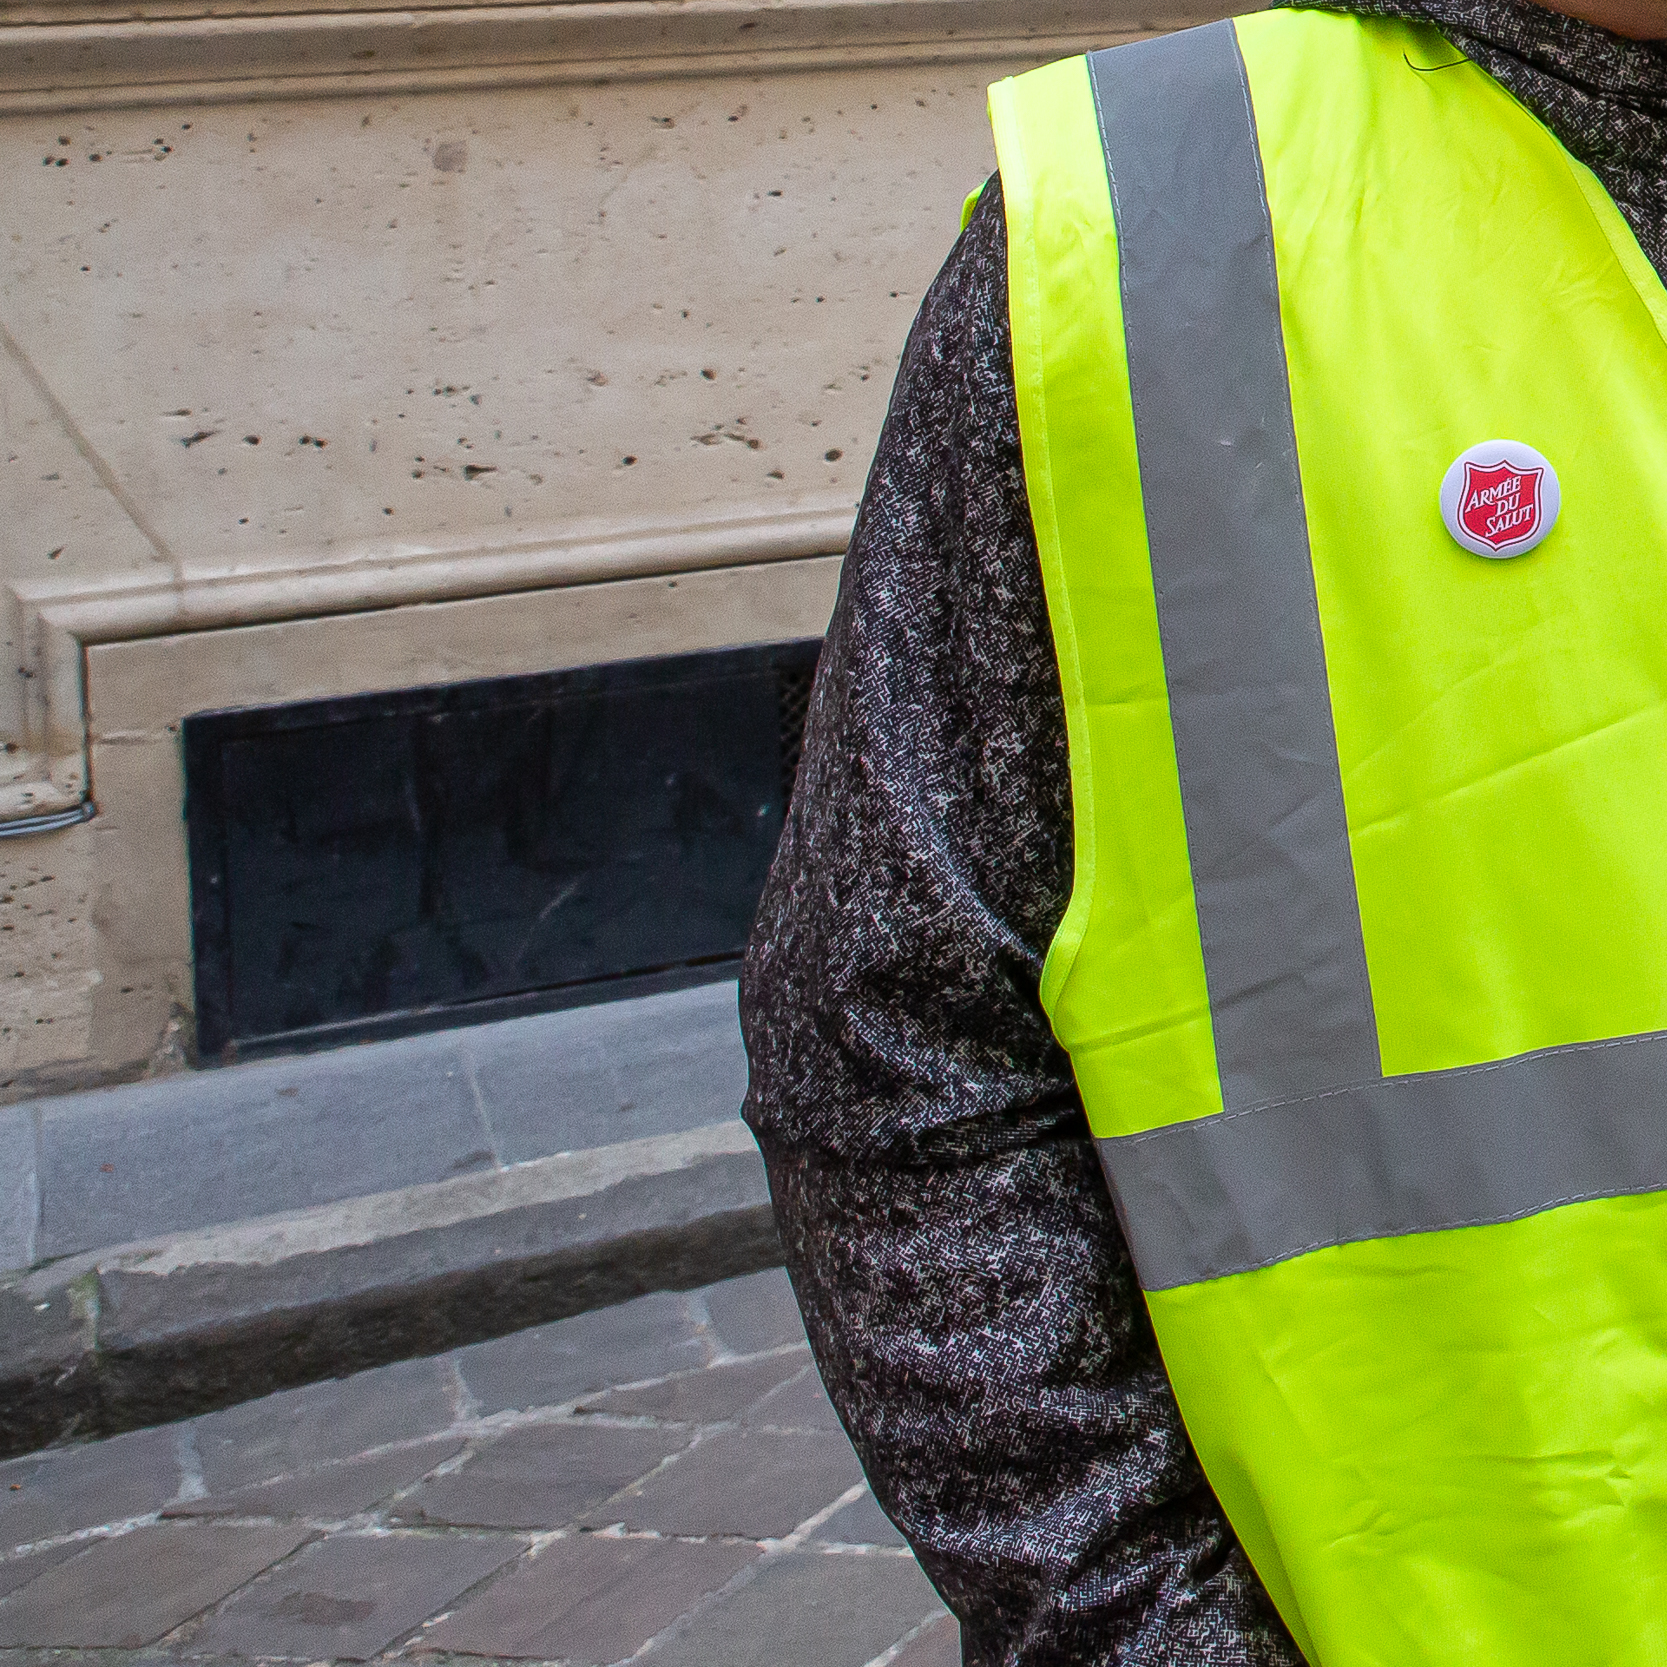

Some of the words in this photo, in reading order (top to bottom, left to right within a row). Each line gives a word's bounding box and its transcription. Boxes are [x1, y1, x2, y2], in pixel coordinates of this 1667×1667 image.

[1464, 475, 1522, 514] ARMÉE
[1494, 492, 1521, 518] DU
[1485, 503, 1534, 538] SALUT
